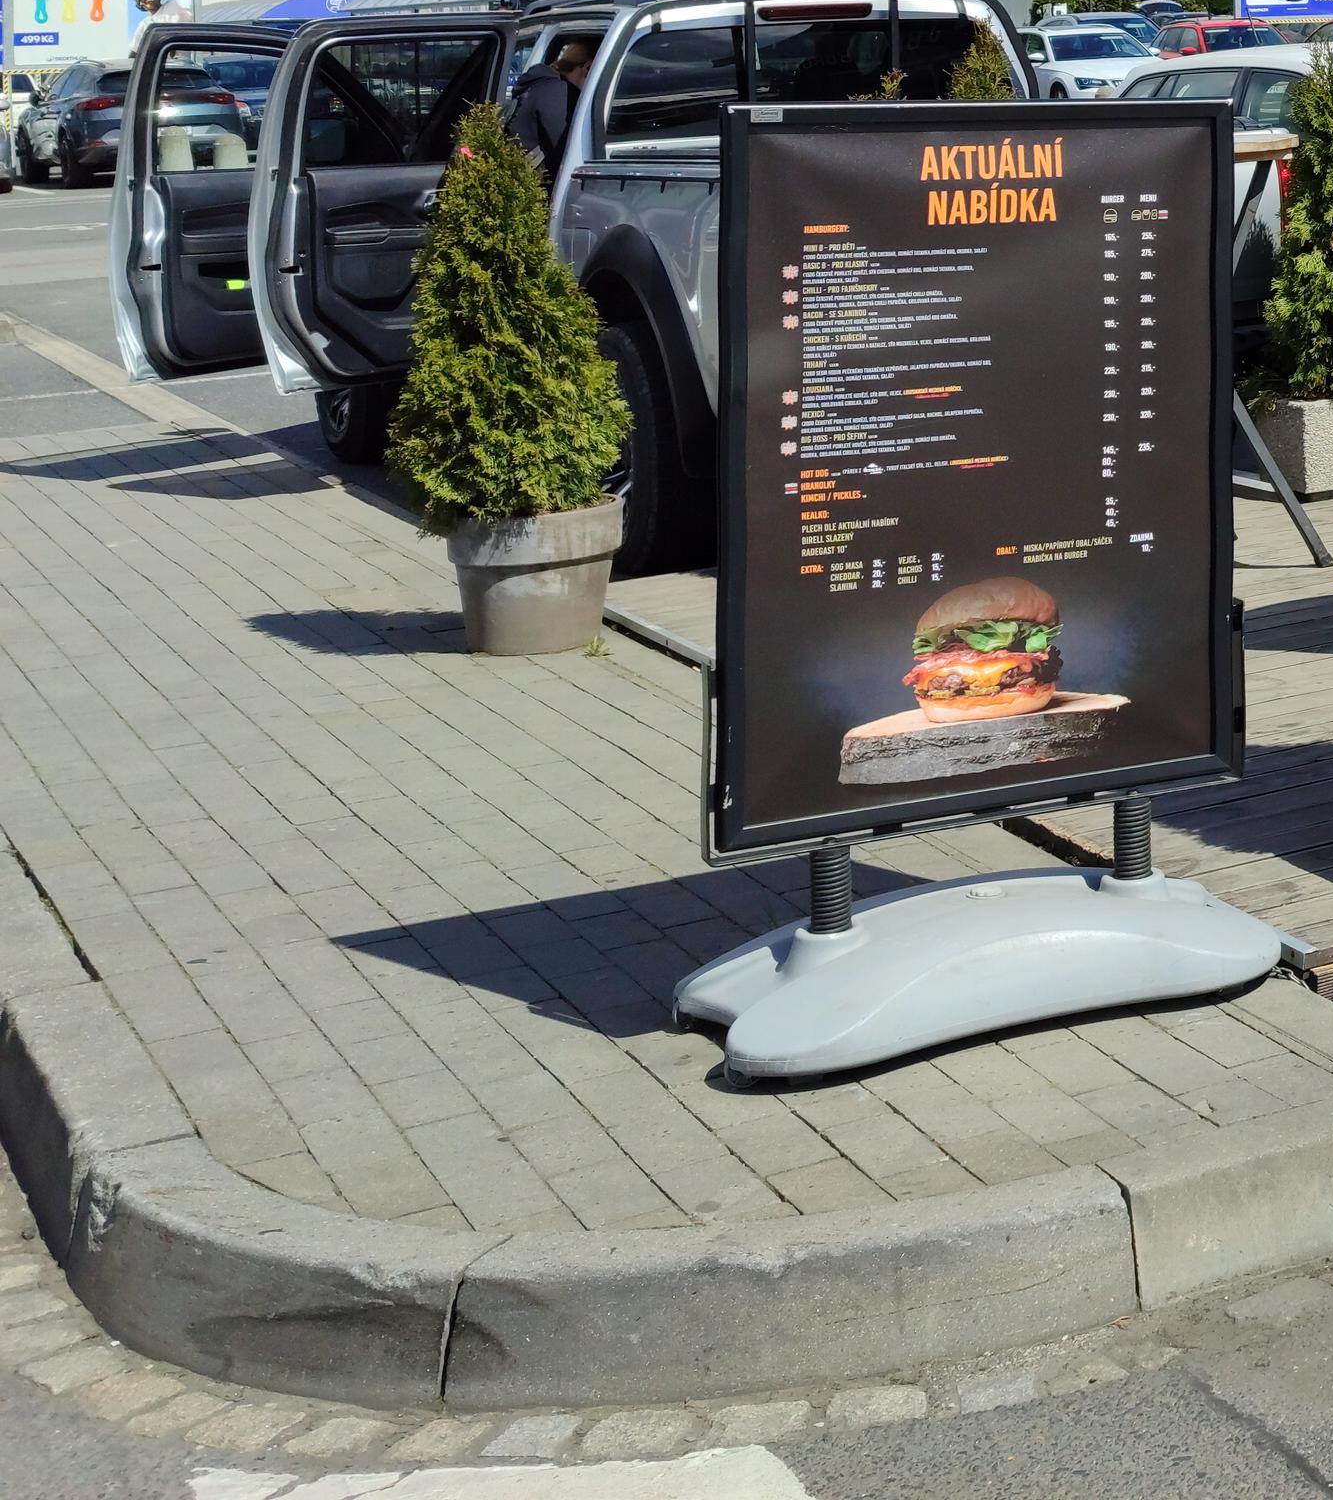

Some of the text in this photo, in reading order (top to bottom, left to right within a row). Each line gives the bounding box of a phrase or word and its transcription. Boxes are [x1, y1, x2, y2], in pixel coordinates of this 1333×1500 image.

[20, 34, 55, 44] 499 Kč
[920, 137, 1063, 181] AKTUÁLNÍ
[1101, 194, 1157, 203] BURGER MENU
[927, 182, 1057, 226] NABÍDKA
[803, 224, 850, 234] HAMBURGERY:
[802, 260, 869, 270] BASIC PRO KLASIKY
[802, 285, 822, 294] CHILLI
[827, 285, 840, 293] PRO
[802, 310, 824, 319] BACON
[803, 335, 830, 344] CHICKEN
[801, 410, 825, 419] MEXICO
[812, 434, 828, 443] BOSS
[833, 433, 845, 442] PRO
[1101, 457, 1116, 466] 80,-
[800, 469, 829, 478] HOT DOG
[1101, 469, 1116, 477] 80,-
[800, 481, 836, 490] HRANOLKY
[800, 490, 861, 503] KIMCHI PICKLES
[800, 510, 829, 520] NEALKO:
[801, 517, 900, 534] PLECH DLE AKTUÁLNÍ NABÍDKY
[801, 532, 855, 545] BIRELL SLAZENÝ
[1129, 532, 1154, 543] ZDARMA
[996, 536, 1113, 556] OBALY: MISKA/PAPÍROVÝ OBAL/SÁČEK
[801, 547, 835, 557] RADEGAST
[931, 552, 945, 561] 20,-
[1023, 550, 1088, 564] KRABIČKA NA BURGER
[898, 555, 917, 565] VEJCE
[800, 564, 824, 574] EXTRA:
[845, 561, 863, 570] MASA
[897, 565, 923, 575] NACHOS
[830, 571, 860, 582] CHEDDAR
[871, 569, 886, 578] 20,-
[871, 580, 886, 588] 20,-
[897, 575, 917, 585] CHILLI
[829, 582, 857, 592] SLANINA
